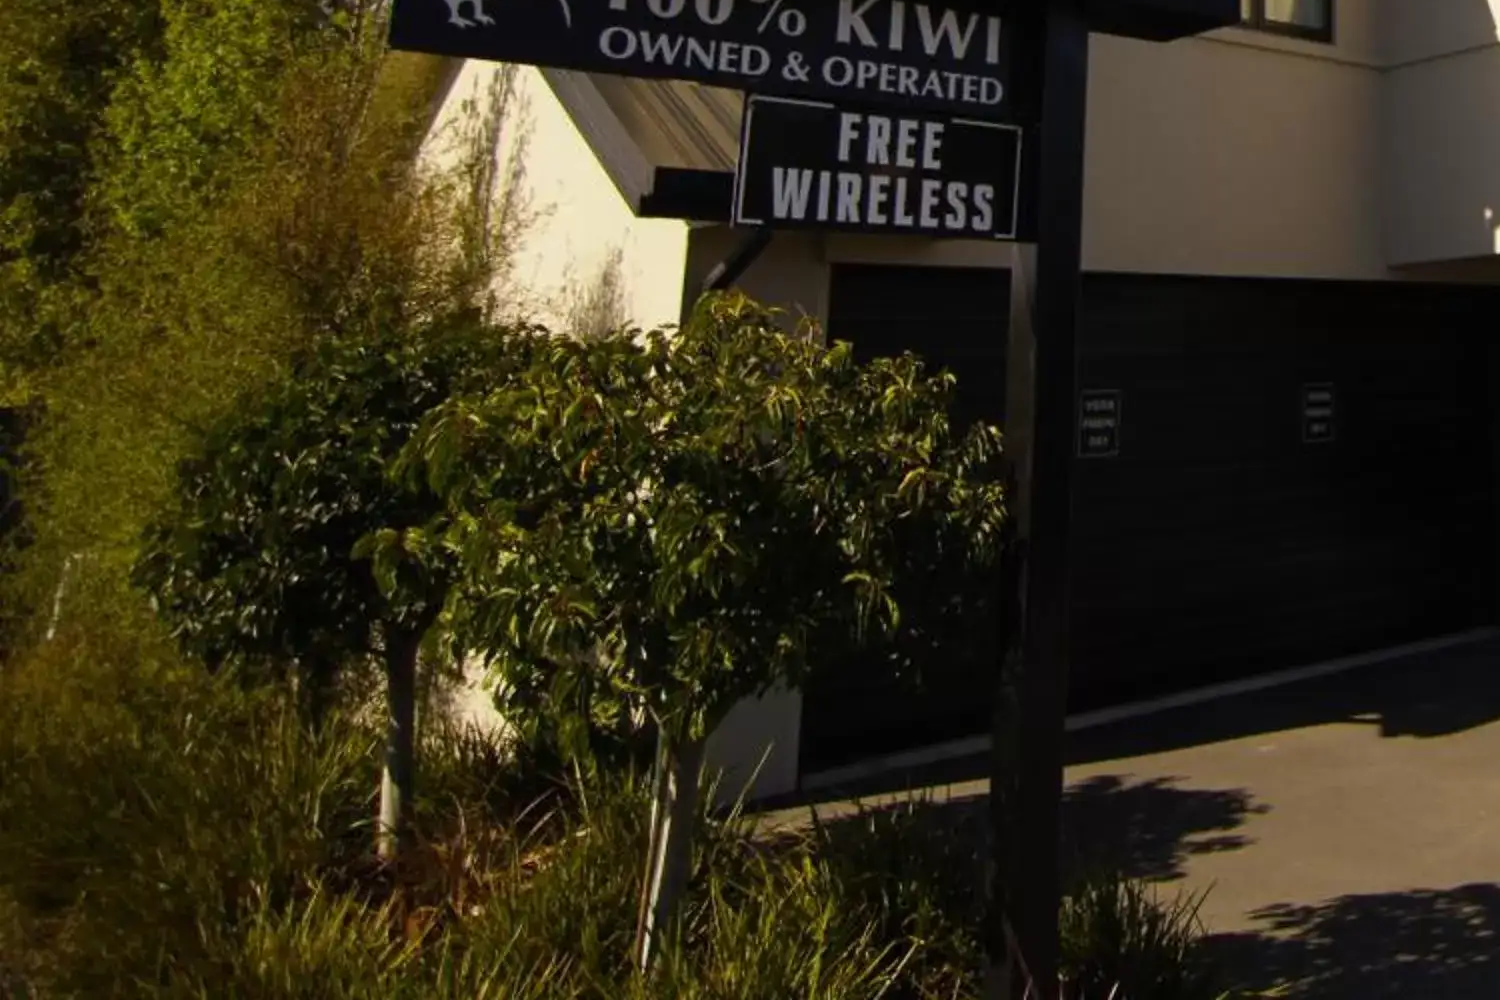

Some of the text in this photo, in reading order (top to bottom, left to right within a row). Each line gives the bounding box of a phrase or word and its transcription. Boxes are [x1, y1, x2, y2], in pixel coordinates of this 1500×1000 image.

[598, 25, 1004, 106] OWNED & OPERATED
[837, 111, 945, 171] FREE
[771, 165, 997, 232] WIRELESS
